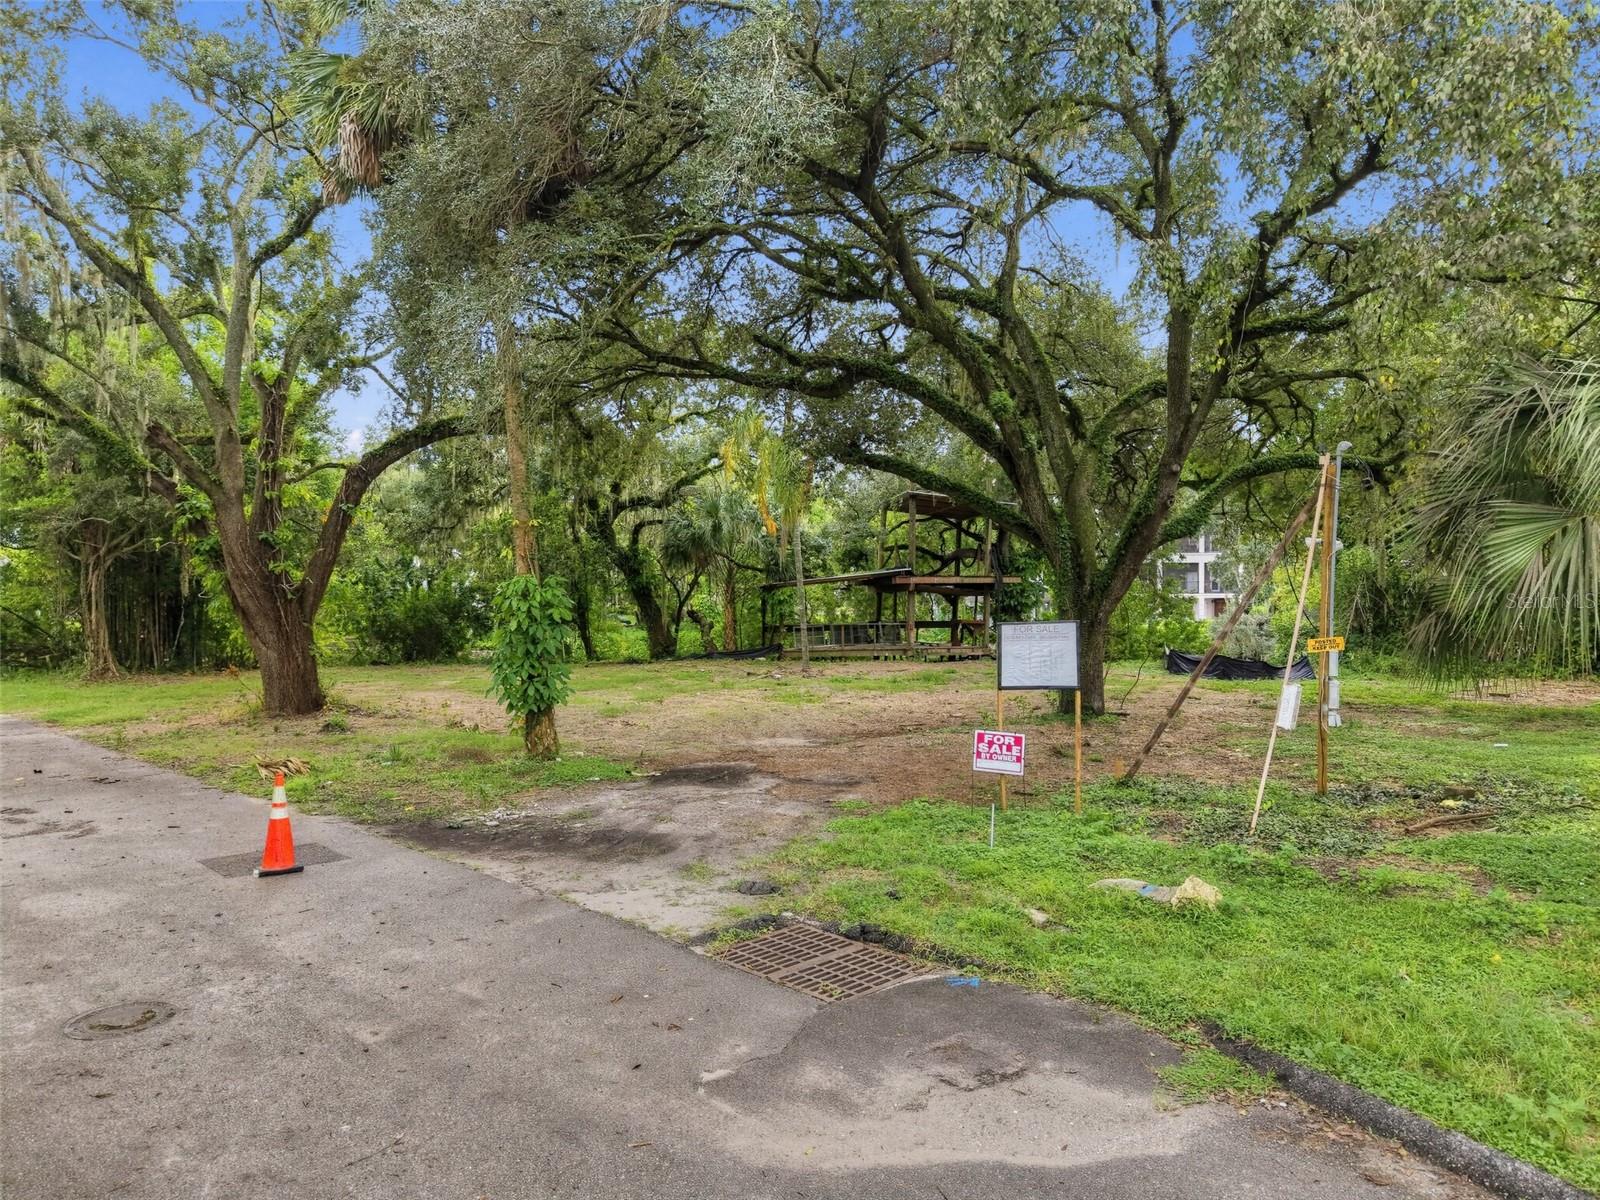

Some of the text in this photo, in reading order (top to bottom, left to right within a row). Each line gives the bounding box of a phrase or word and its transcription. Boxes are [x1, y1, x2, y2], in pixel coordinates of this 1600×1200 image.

[1013, 624, 1060, 633] FOR SALE
[984, 734, 1015, 745] FOR
[978, 742, 1021, 756] SALE
[992, 753, 1017, 762] OWNER
